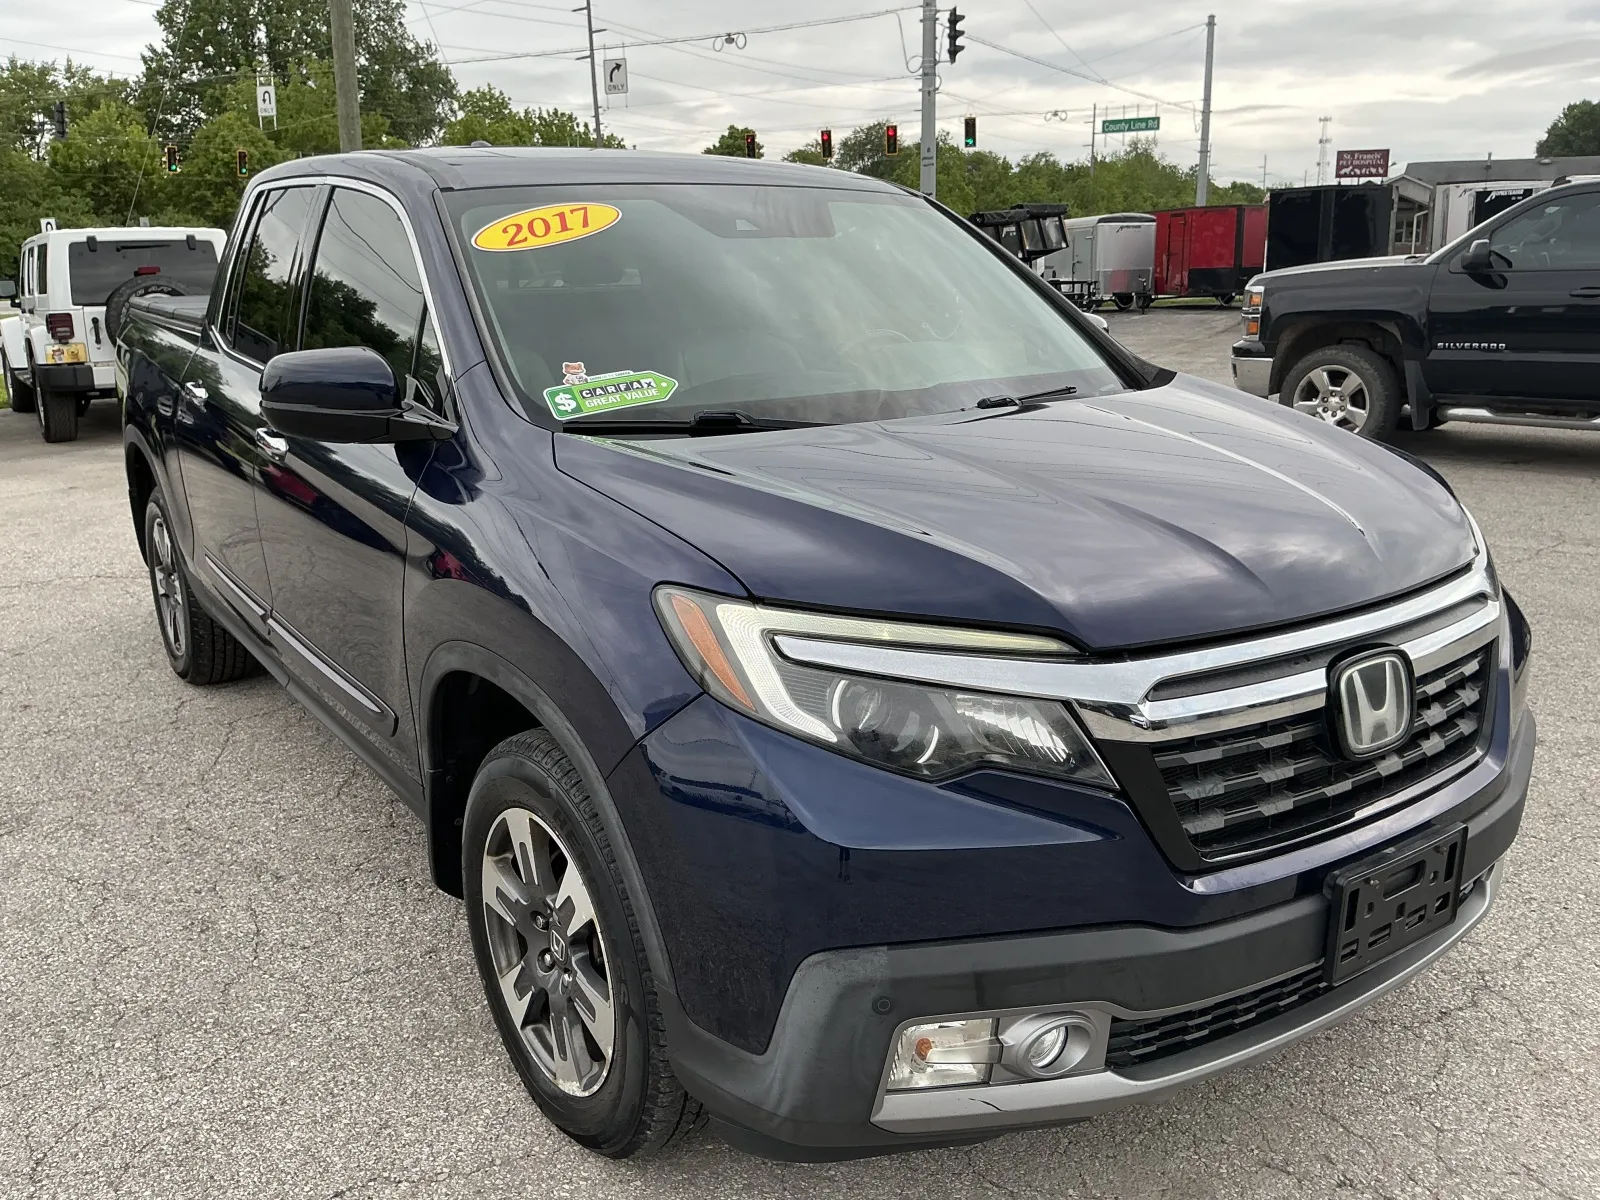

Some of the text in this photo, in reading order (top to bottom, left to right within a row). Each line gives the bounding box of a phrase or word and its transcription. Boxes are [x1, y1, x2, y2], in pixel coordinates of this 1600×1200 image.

[1104, 119, 1158, 131] County Line Rd
[502, 207, 589, 247] 2017
[1437, 342, 1506, 350] SILVERADO
[580, 379, 656, 399] CARFAX
[586, 388, 660, 409] GREAT VALUE
